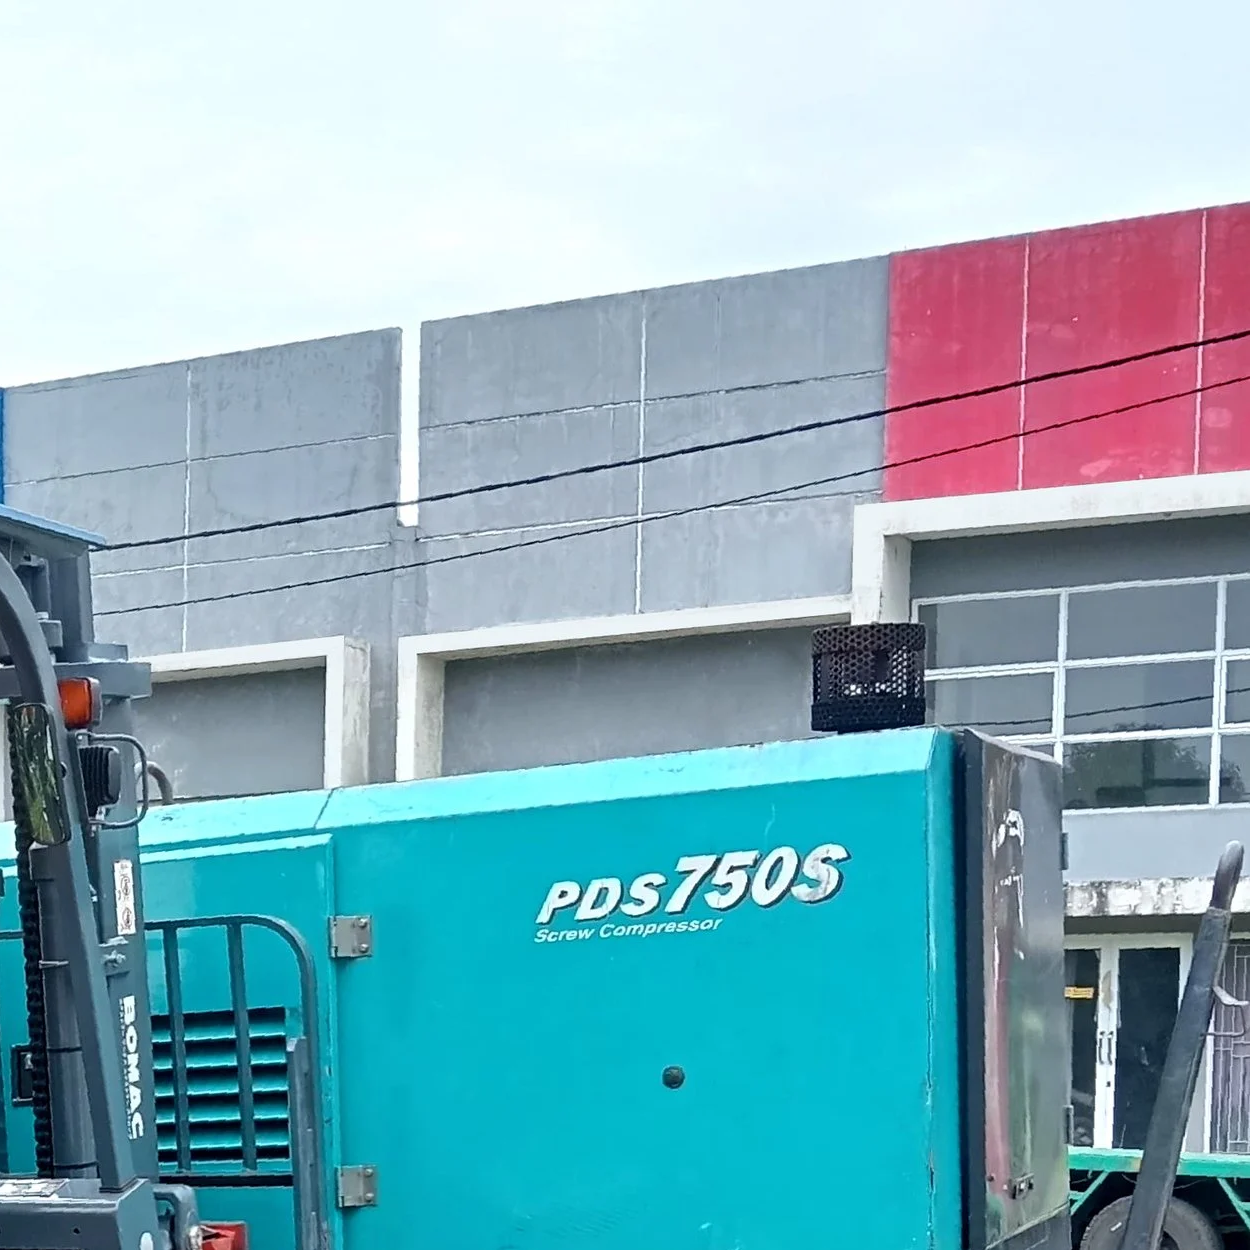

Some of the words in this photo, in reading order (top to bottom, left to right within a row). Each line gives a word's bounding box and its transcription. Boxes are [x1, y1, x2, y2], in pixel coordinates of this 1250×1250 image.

[535, 843, 851, 925] PDS750S
[534, 926, 595, 944] Screw
[599, 917, 724, 939] Compressor
[122, 995, 144, 1140] BOMAC
